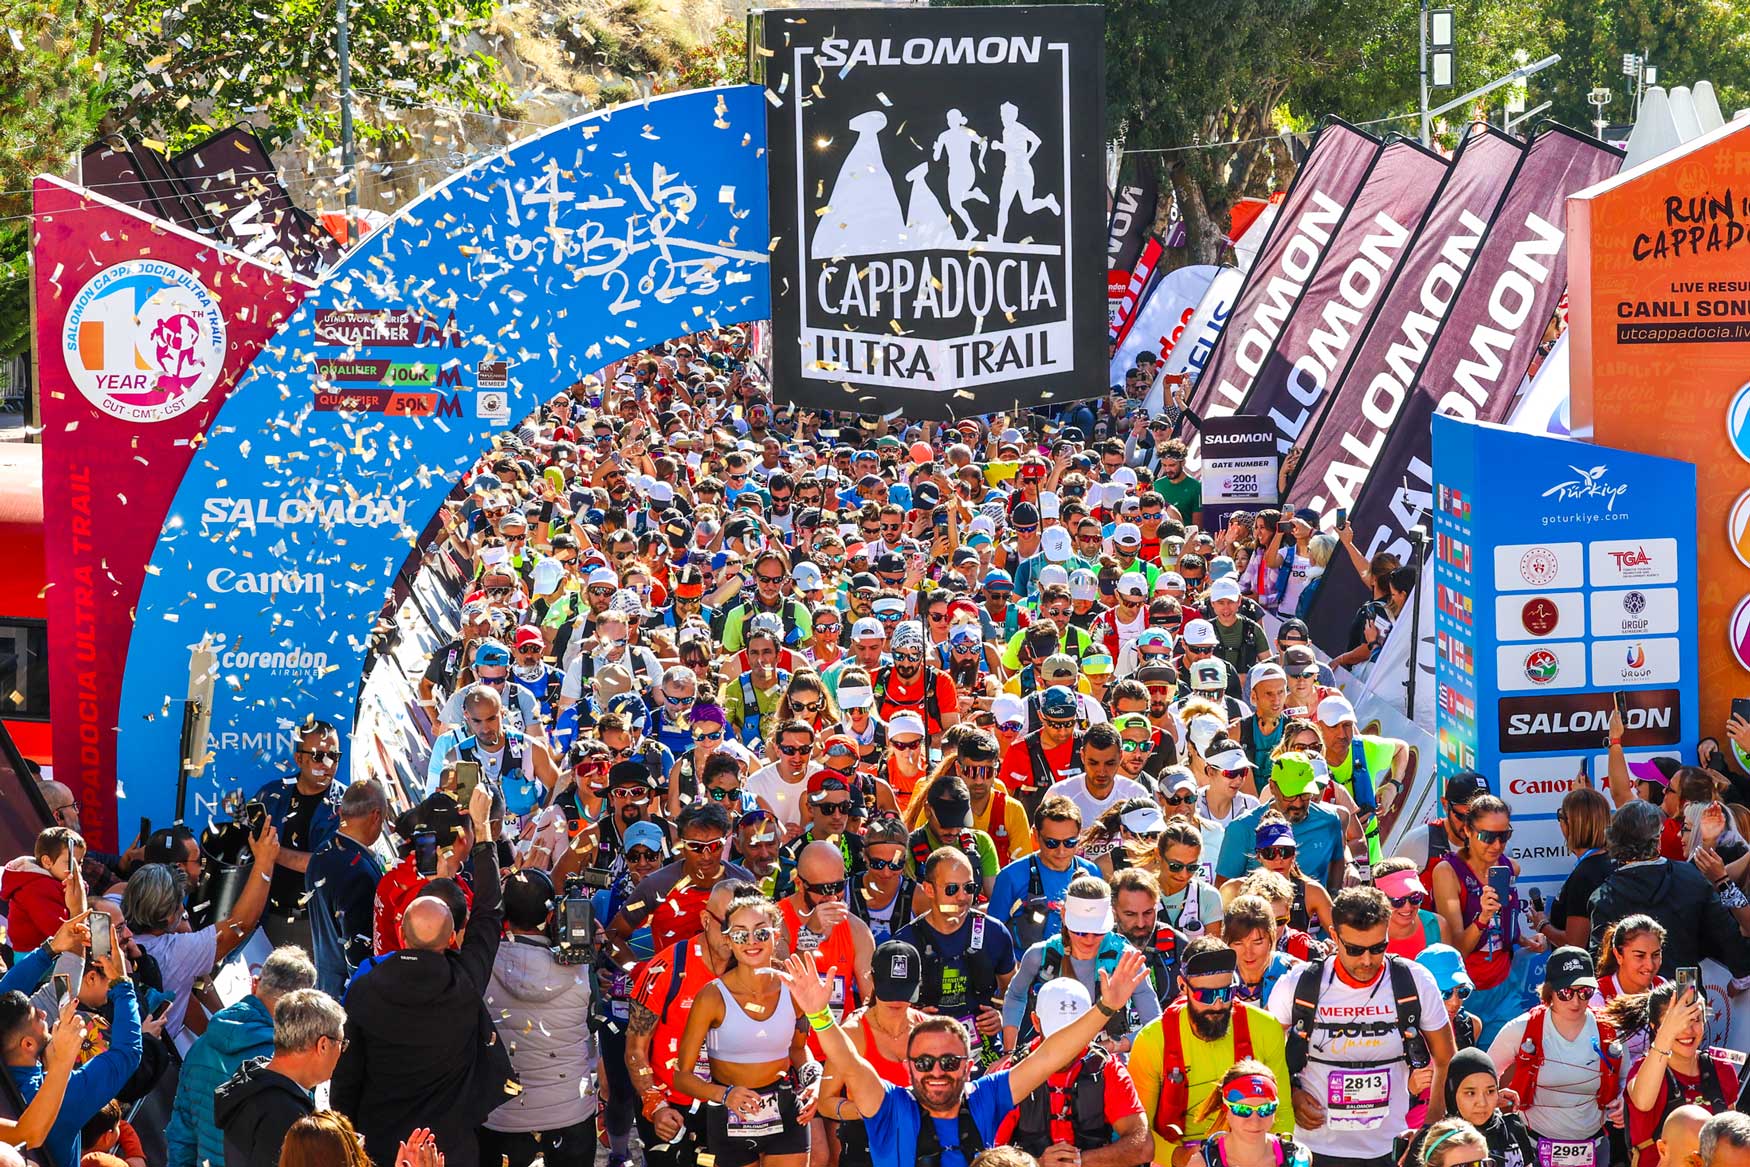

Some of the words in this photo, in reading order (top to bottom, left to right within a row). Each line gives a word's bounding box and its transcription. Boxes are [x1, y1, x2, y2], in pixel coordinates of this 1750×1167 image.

[819, 36, 1042, 67] SALOMON
[1665, 188, 1734, 227] RUN
[602, 256, 731, 316] 2023
[817, 256, 1058, 319] CAPPADOCIA
[1671, 282, 1704, 293] LIVE
[1708, 281, 1750, 292] RESU
[67, 287, 96, 351] SALOMON
[177, 274, 212, 308] ULTRA
[206, 308, 223, 347] TRAIL
[1617, 302, 1690, 317] CANLI
[1696, 300, 1750, 316] SON
[814, 334, 936, 381] ULTRA
[949, 331, 1058, 377] TRAIL
[95, 374, 147, 389] YEAR
[102, 398, 126, 415] CUT
[164, 399, 186, 415] CST
[1205, 433, 1273, 445] SALOMON
[1212, 461, 1233, 469] GATE
[1234, 460, 1270, 468] NUMBER
[1232, 474, 1257, 483] 2001
[1232, 483, 1258, 492] 2200
[70, 464, 92, 555] TRAIL
[203, 498, 406, 525] SALOMON
[1541, 512, 1629, 526] goturkiye.com
[1608, 546, 1652, 572] TGA
[207, 567, 325, 594] Canon
[72, 566, 96, 660] ULTRA
[222, 646, 328, 669] corendon
[1320, 1005, 1394, 1017] MERRELL
[1344, 1076, 1382, 1090] 2813
[1553, 1145, 1588, 1157] 2987
